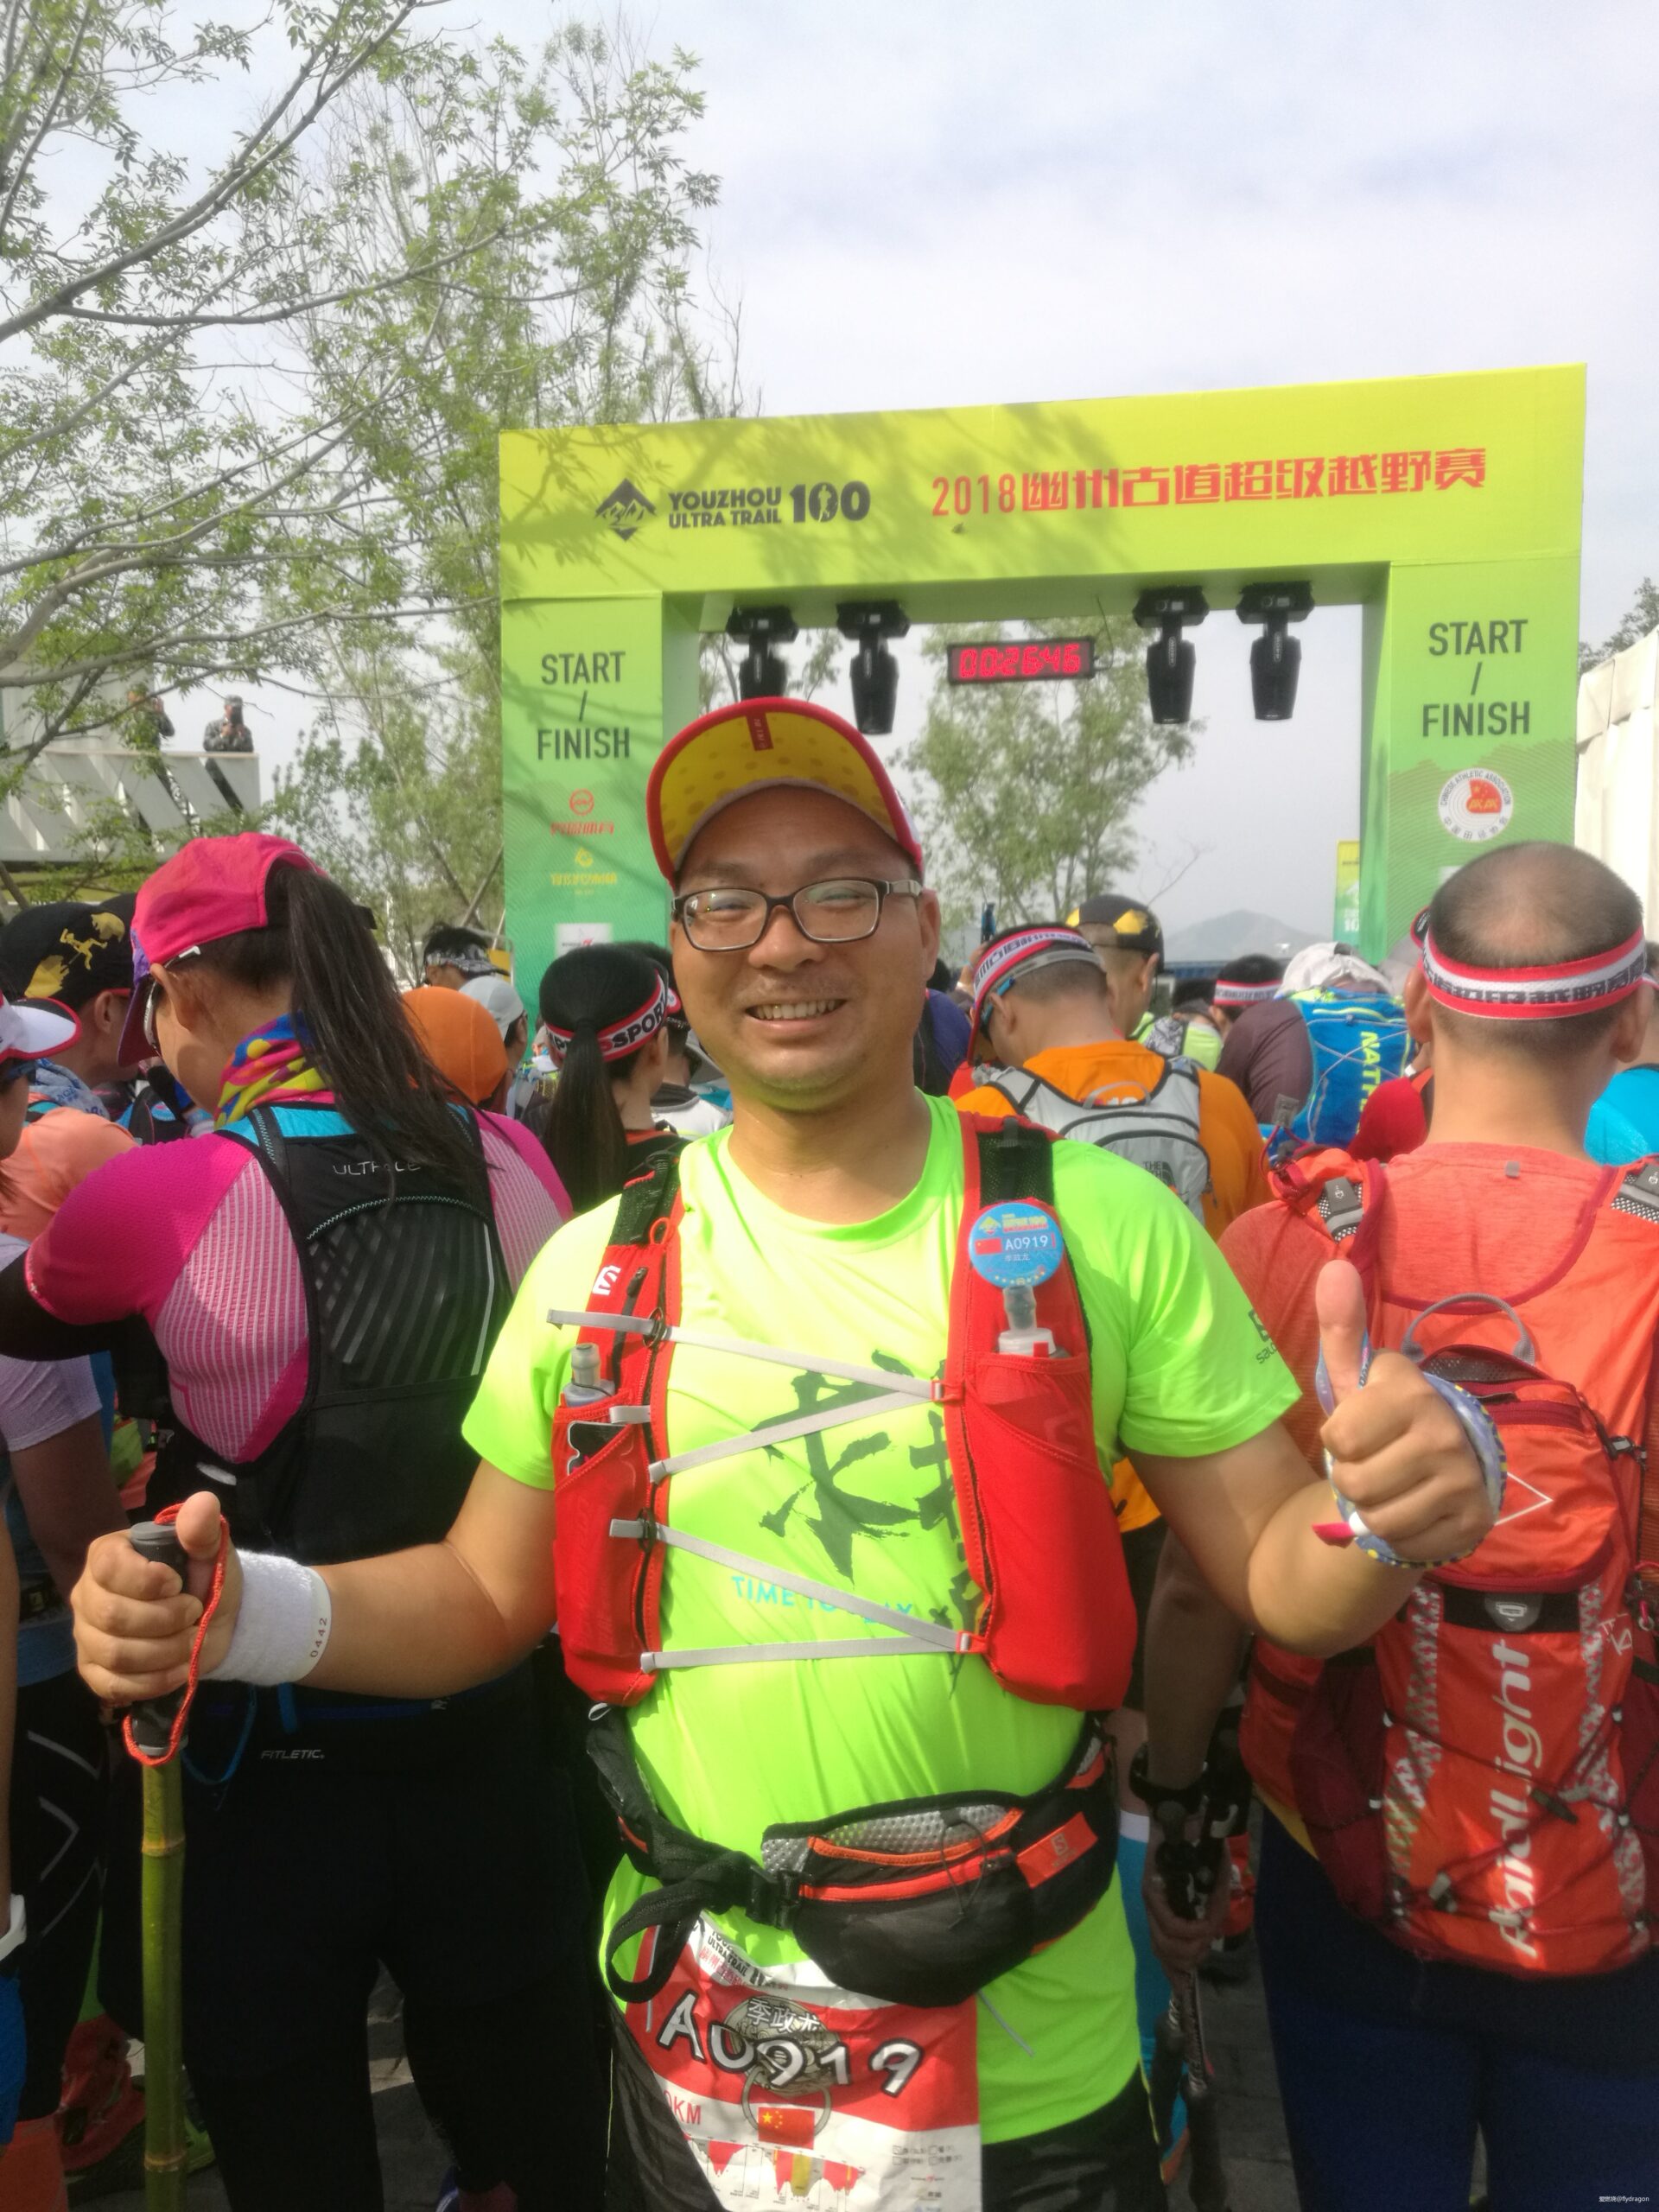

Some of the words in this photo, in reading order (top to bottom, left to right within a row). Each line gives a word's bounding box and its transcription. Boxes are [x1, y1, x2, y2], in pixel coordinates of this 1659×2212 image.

[668, 487, 782, 510] YOUZHOU
[790, 480, 871, 524] 100
[668, 512, 726, 529] ULTRA
[731, 509, 782, 527] TRAIL
[1428, 619, 1529, 657] START
[541, 651, 626, 685] START
[1422, 701, 1530, 737] FINISH
[537, 726, 631, 761] FINISH
[613, 991, 666, 1049] SPOR
[1143, 1160, 1161, 1171] THE
[1005, 1235, 1049, 1251] A0919
[731, 1575, 796, 1607] TIME
[309, 1617, 327, 1658] 0442
[261, 1749, 321, 1760] FITLETIC
[727, 1954, 749, 1977] TRAIL
[656, 1989, 925, 2098] A0919
